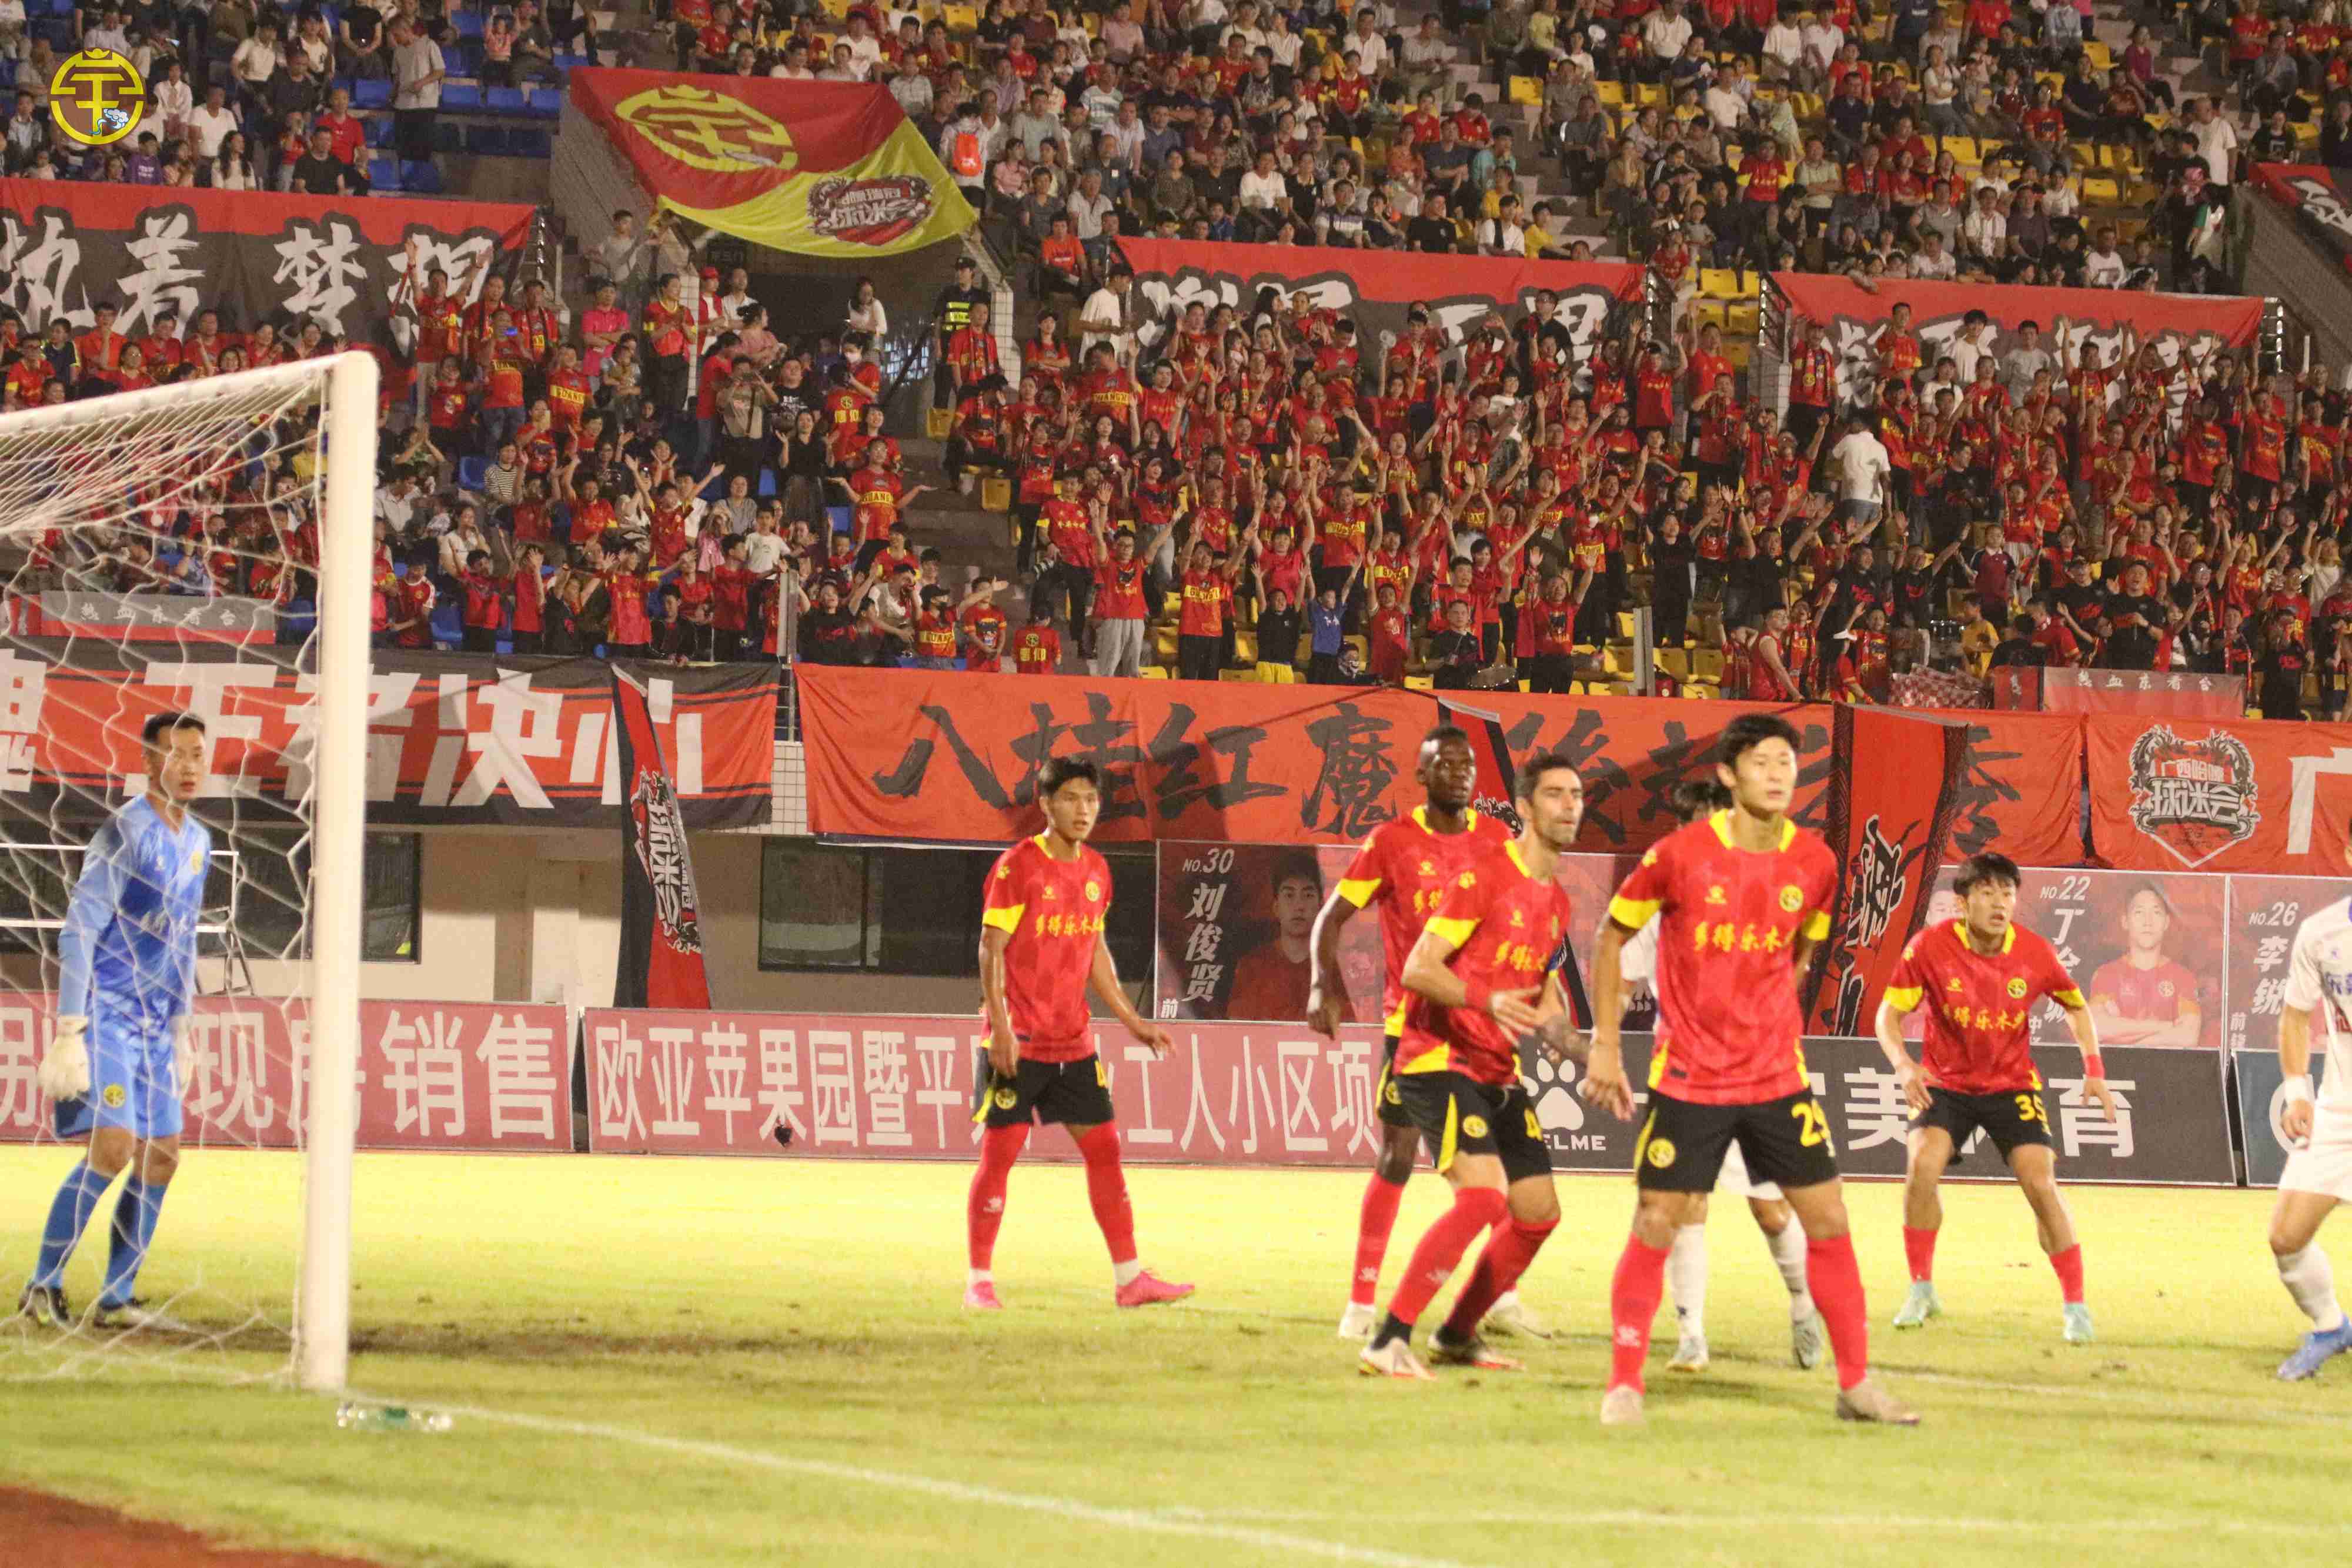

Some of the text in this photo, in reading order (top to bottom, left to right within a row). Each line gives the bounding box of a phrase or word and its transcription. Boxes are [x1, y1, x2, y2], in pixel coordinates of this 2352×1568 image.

[2149, 780, 2240, 824] 球迷会
[1182, 848, 1235, 874] NO.30
[2040, 876, 2090, 901] NO.22
[2249, 901, 2298, 927] NO.26
[1181, 883, 1227, 1002] 刘俊贤
[1543, 1134, 1606, 1151] ELME
